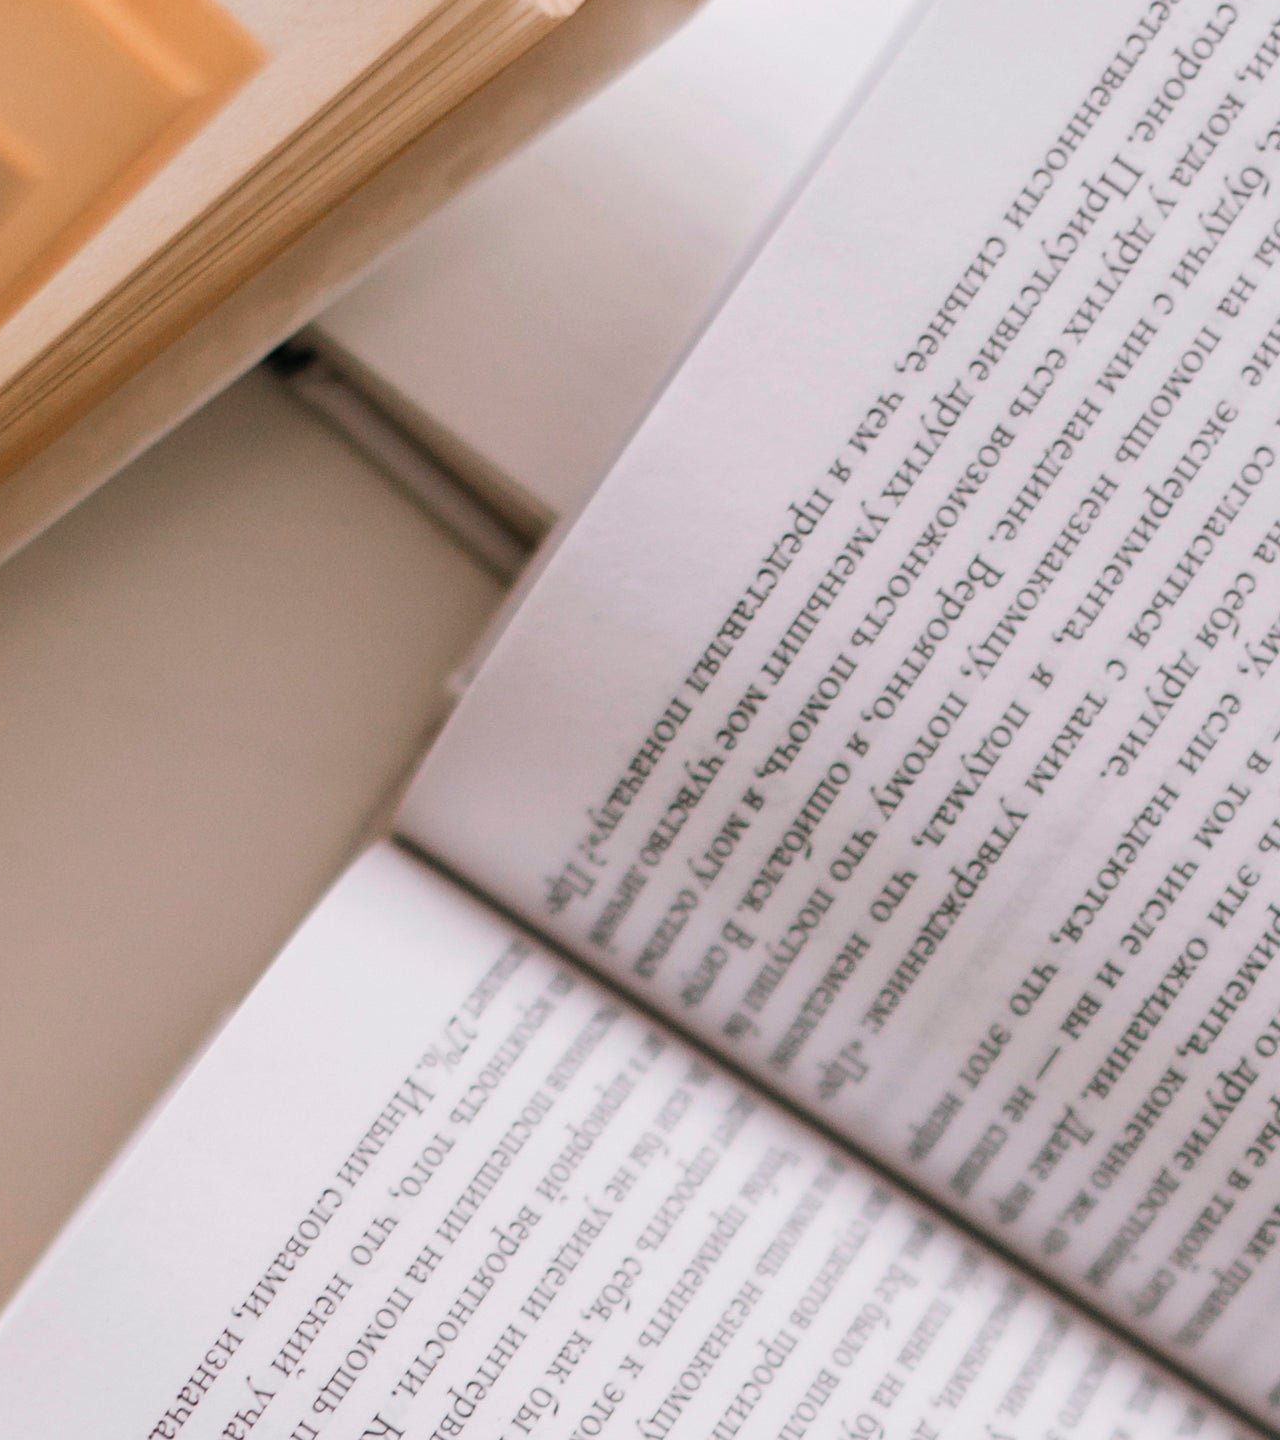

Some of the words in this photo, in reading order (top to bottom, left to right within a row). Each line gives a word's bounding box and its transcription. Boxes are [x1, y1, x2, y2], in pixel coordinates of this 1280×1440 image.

[1193, 570, 1258, 652] себя
[1097, 648, 1202, 780] другие.
[229, 1186, 344, 1321] словами,
